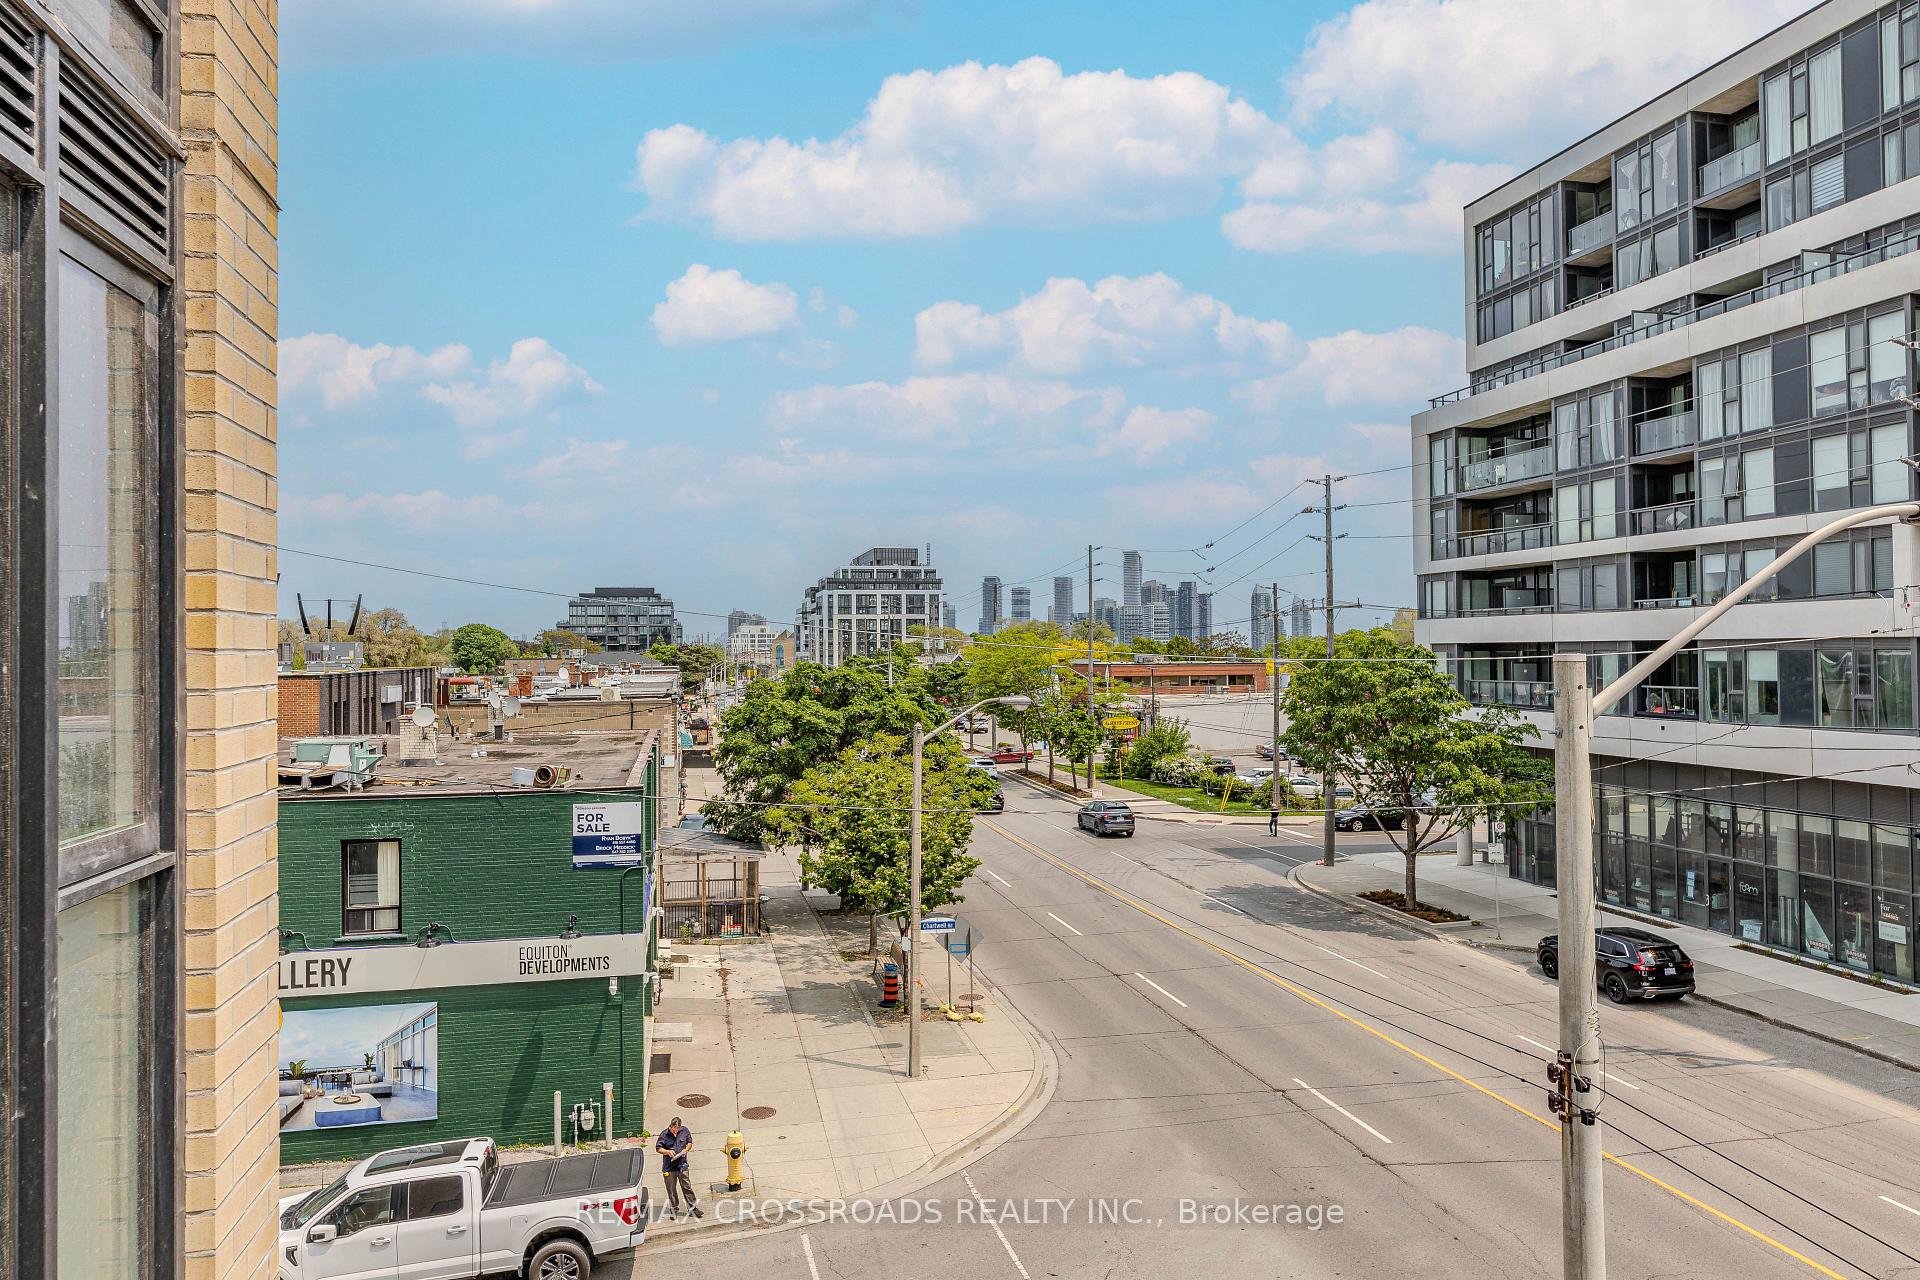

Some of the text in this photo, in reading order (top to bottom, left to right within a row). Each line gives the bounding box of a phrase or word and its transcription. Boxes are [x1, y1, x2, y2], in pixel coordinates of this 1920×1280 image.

[577, 813, 604, 823] FOR
[577, 823, 610, 833] SALE
[922, 922, 946, 930] Chartwell
[519, 944, 568, 961] EQUITON
[519, 955, 610, 975] DEVELOPMENTS
